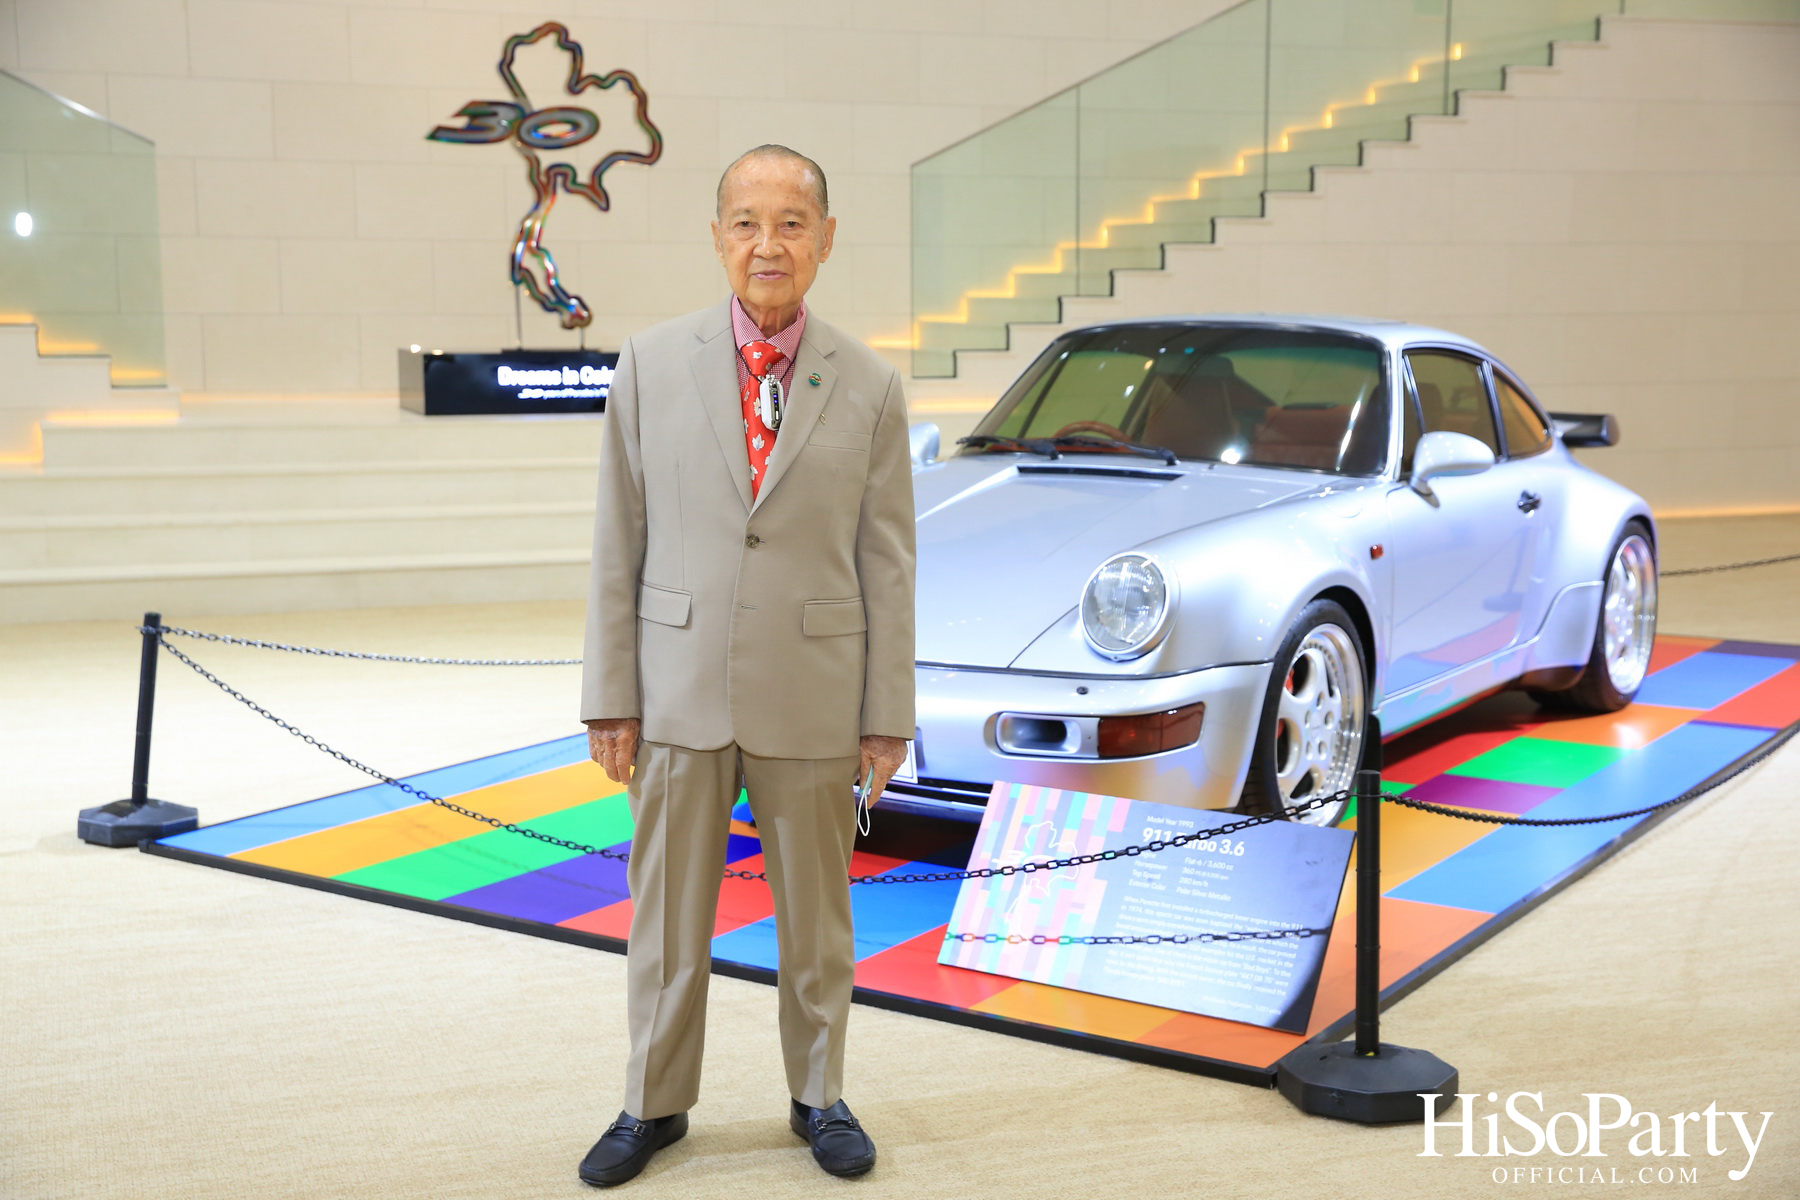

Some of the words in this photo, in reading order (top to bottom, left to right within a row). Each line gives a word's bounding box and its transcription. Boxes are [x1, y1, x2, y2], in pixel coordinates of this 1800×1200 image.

[426, 101, 600, 149] 30
[498, 366, 561, 386] Dreams
[562, 366, 579, 385] in
[580, 366, 616, 385] Colo
[1146, 815, 1164, 823] Model
[1143, 827, 1171, 843] 911
[1219, 839, 1246, 857] 3.6
[1134, 860, 1168, 871] Horsepower
[1184, 857, 1203, 865] Flat-6
[1132, 869, 1143, 877] Top
[1142, 871, 1161, 880] Speed
[1128, 878, 1151, 888] Exterior
[1151, 882, 1166, 890] Color
[1176, 886, 1191, 894] Polar
[1191, 889, 1208, 897] Silver
[1207, 891, 1232, 901] Metallic
